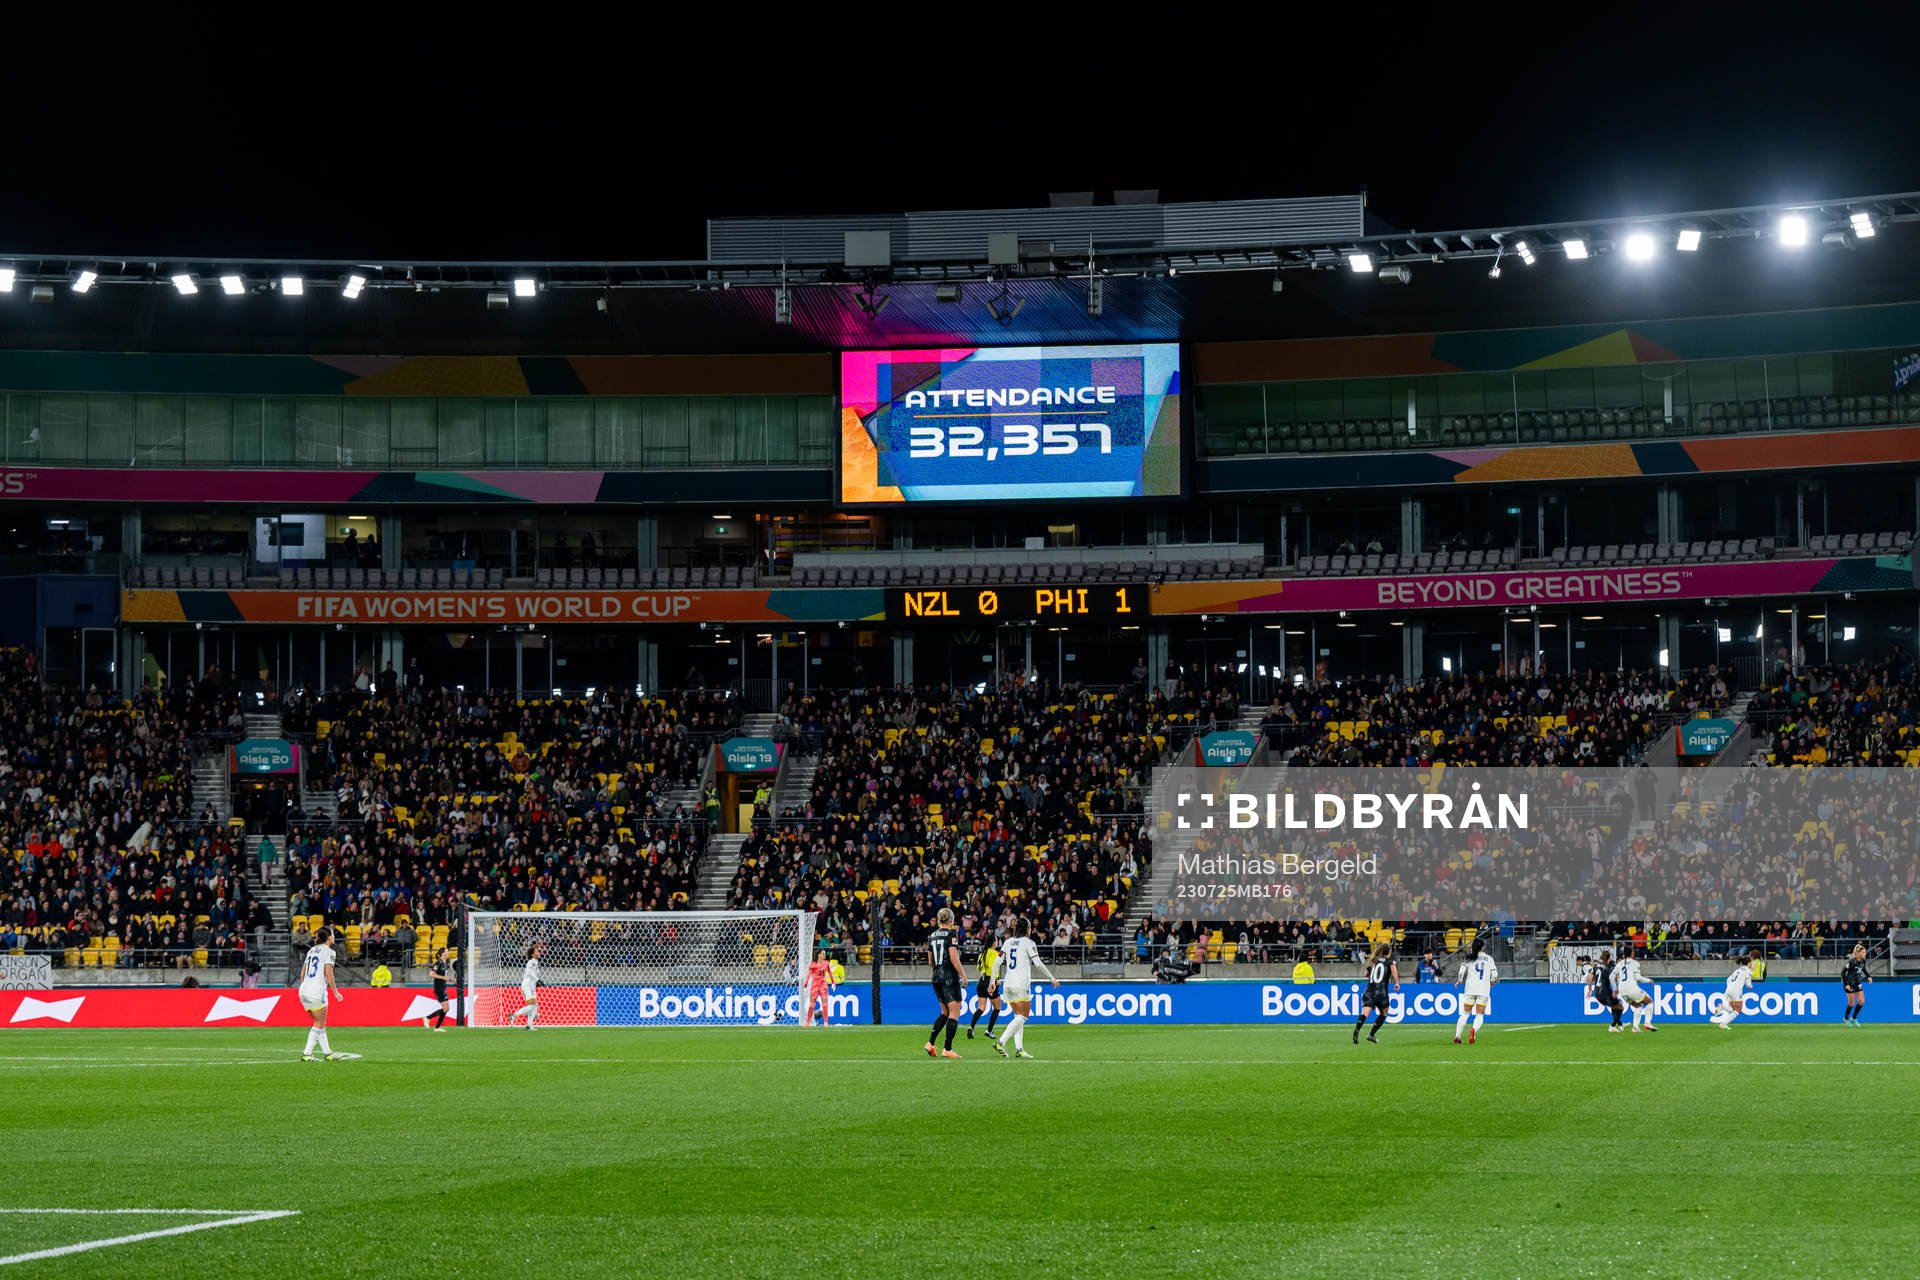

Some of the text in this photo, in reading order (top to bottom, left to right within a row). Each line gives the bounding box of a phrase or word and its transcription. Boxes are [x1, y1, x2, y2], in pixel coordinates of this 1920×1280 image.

[905, 386, 1116, 409] ATTENDANCE
[909, 423, 1112, 461] 32,357
[904, 588, 1131, 617] NZL 0 PHI 1
[1377, 579, 1496, 604] BEYOND
[297, 597, 359, 618] FIFA
[364, 597, 506, 618] WOMEN'S
[515, 597, 622, 617] WORLD
[1689, 735, 1718, 745] Aisle
[240, 755, 289, 765] Aisle 20
[728, 753, 773, 763] Aisle 19
[1207, 747, 1252, 757] Aisle 18
[931, 939, 945, 965] 17
[1009, 948, 1017, 970] 5
[306, 955, 320, 978] 13
[1370, 962, 1385, 984] 10
[1475, 962, 1484, 980] 4
[1551, 959, 1569, 971] ON
[1621, 966, 1628, 982] 3
[1595, 967, 1602, 987] 2
[639, 987, 859, 1024] Booking.cm
[960, 986, 1172, 1024] oing.com
[1262, 985, 1492, 1024] Bookig.co
[1584, 984, 1818, 1023] Bkingcom
